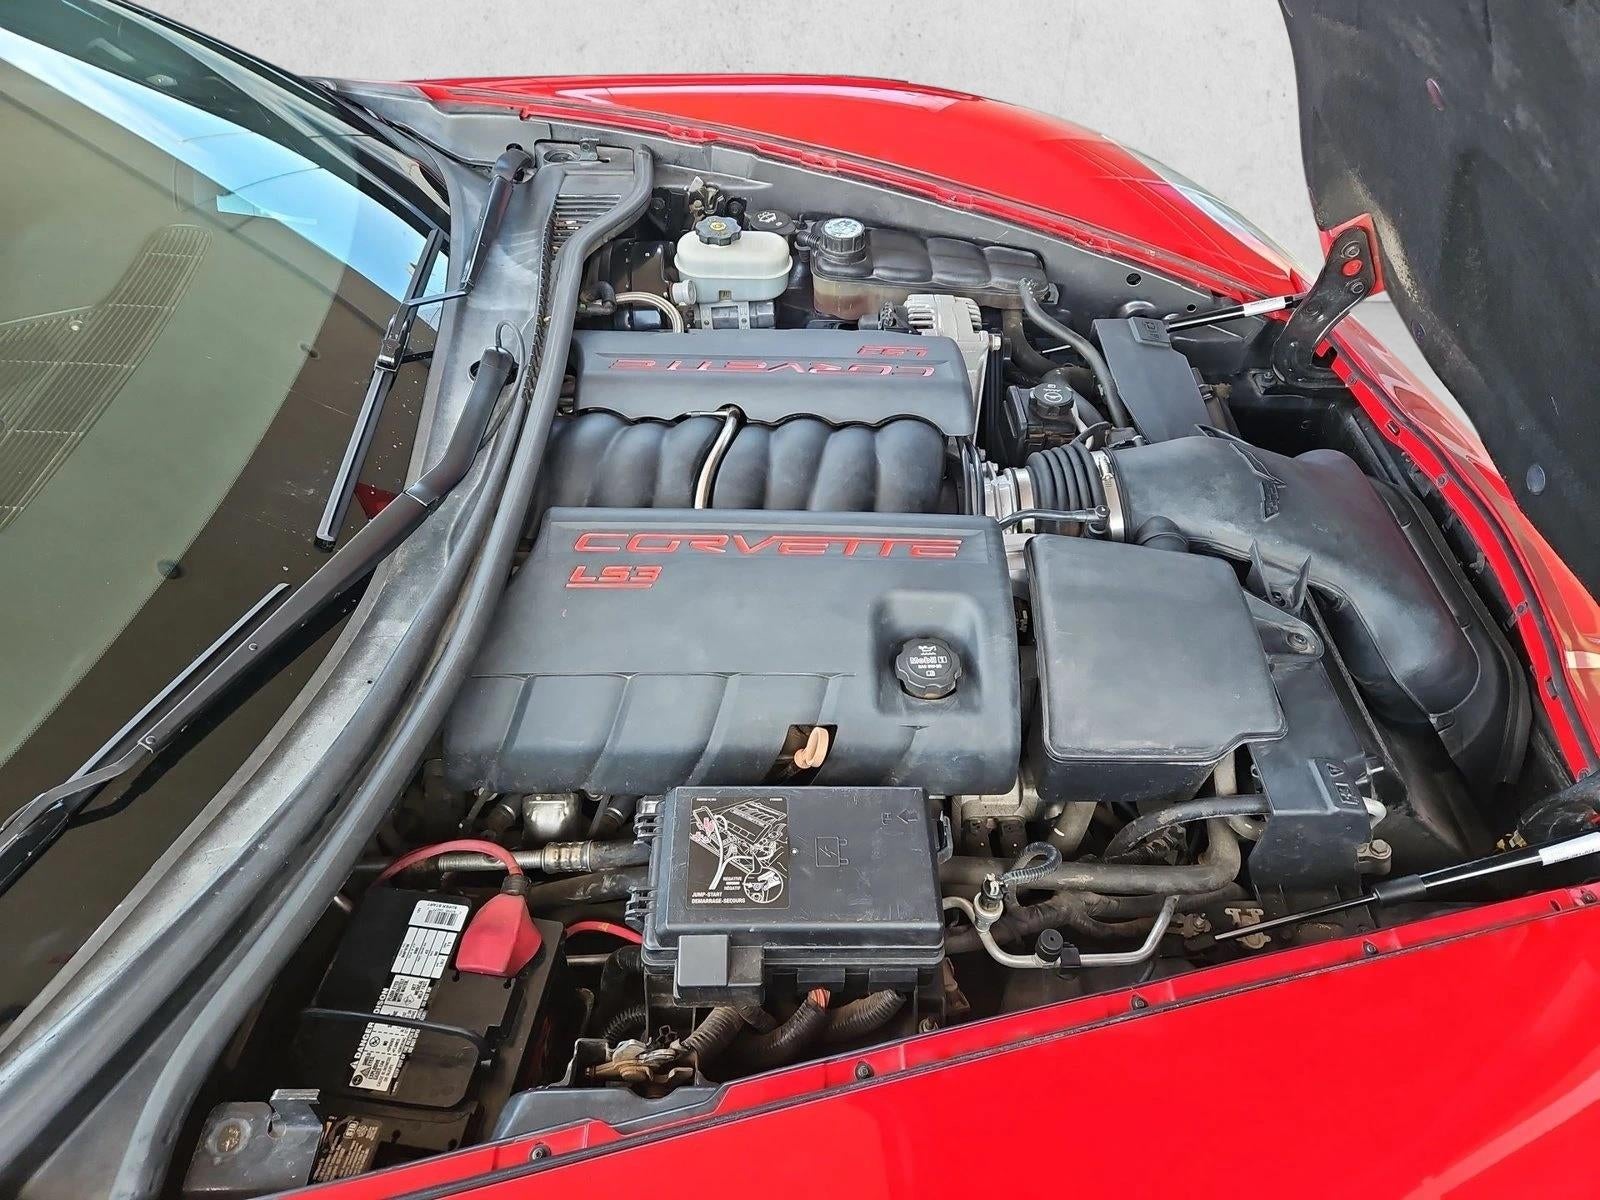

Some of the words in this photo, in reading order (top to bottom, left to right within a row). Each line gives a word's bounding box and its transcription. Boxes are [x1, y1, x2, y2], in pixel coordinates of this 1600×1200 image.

[608, 358, 935, 377] CORVETTE
[574, 532, 963, 561] CORVETTE
[567, 565, 663, 584] LS3
[909, 656, 937, 664] Mobil
[373, 987, 390, 1015] OISON
[354, 1021, 375, 1059] DANGER
